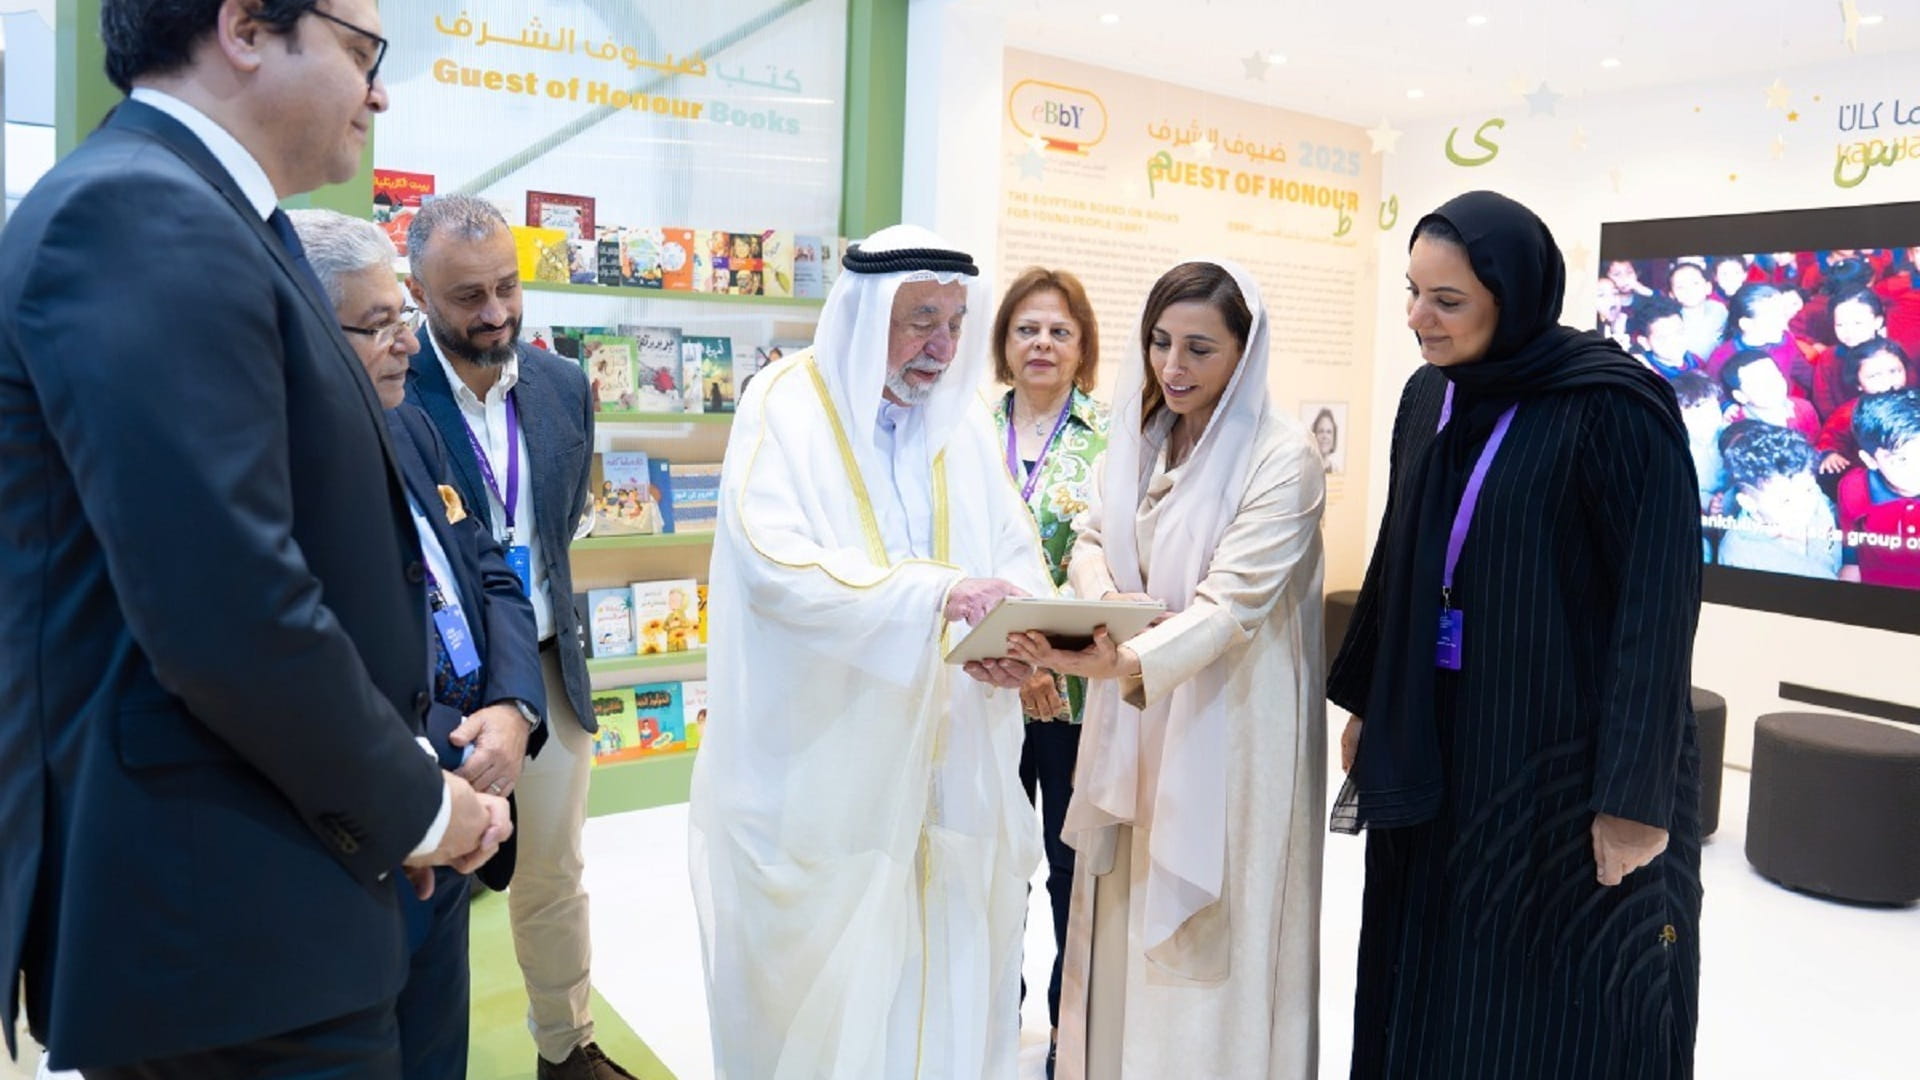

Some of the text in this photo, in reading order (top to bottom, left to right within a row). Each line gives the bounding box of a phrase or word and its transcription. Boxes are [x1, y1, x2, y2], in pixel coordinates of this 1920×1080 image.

[434, 10, 802, 93] كتب ضيوف الشرف
[433, 58, 801, 134] Guest of Honour Books
[1223, 133, 1287, 162] ضيوف
[1299, 140, 1361, 176] 2025
[1008, 191, 1028, 203] THE
[1147, 156, 1230, 191] GUEST
[1234, 172, 1266, 197] OF
[1269, 177, 1359, 212] HONOUR
[1007, 207, 1029, 218] FOR
[1847, 531, 1902, 550] group
[1906, 537, 1920, 550] o
